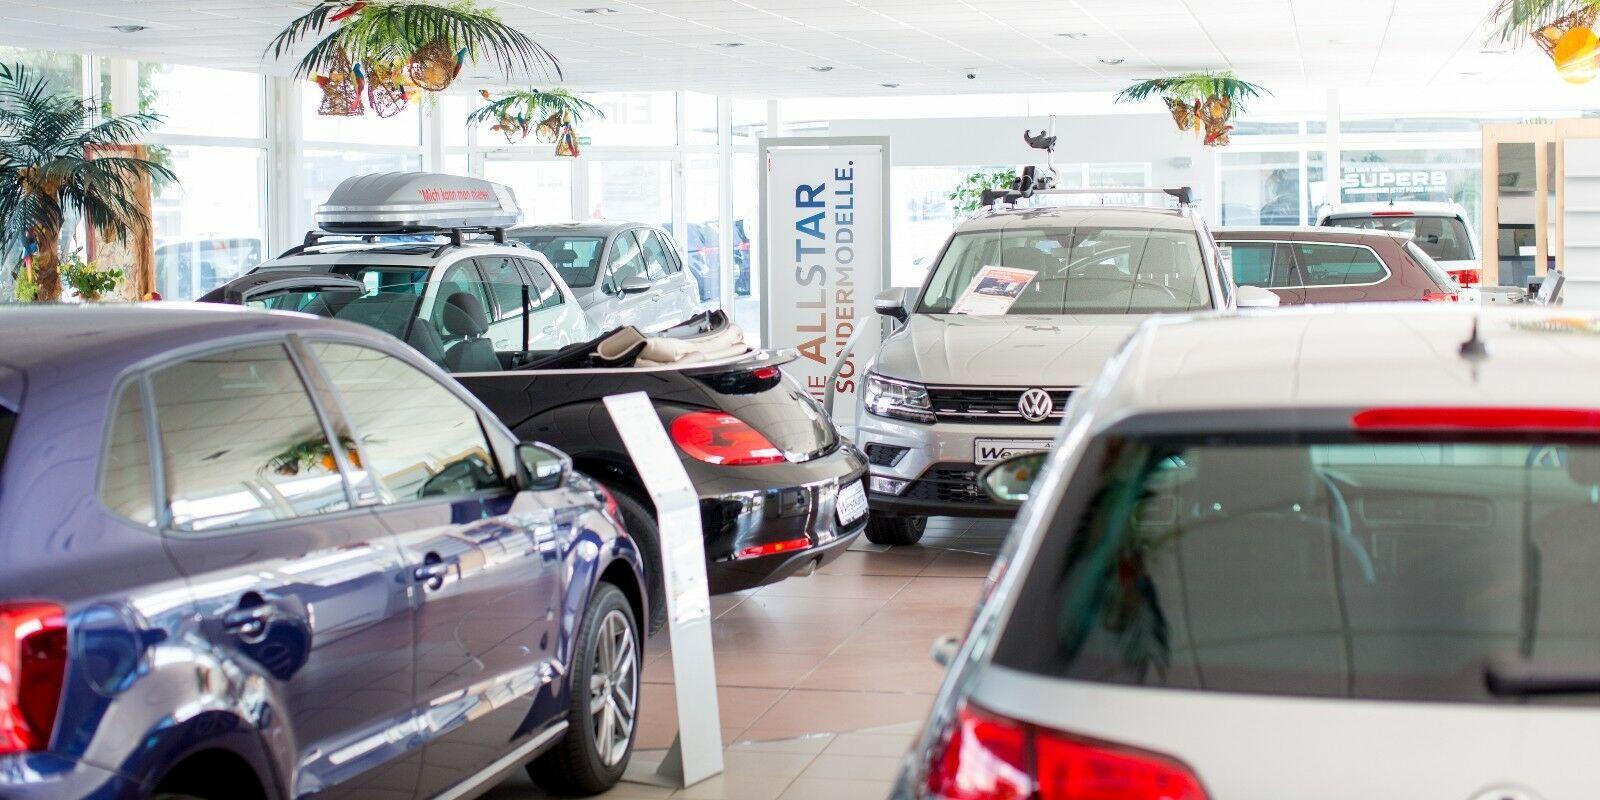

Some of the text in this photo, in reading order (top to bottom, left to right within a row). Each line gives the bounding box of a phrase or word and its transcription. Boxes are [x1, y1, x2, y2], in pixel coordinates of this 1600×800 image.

[1343, 171, 1447, 188] SUPERB
[795, 182, 826, 403] IE ALLSTAR
